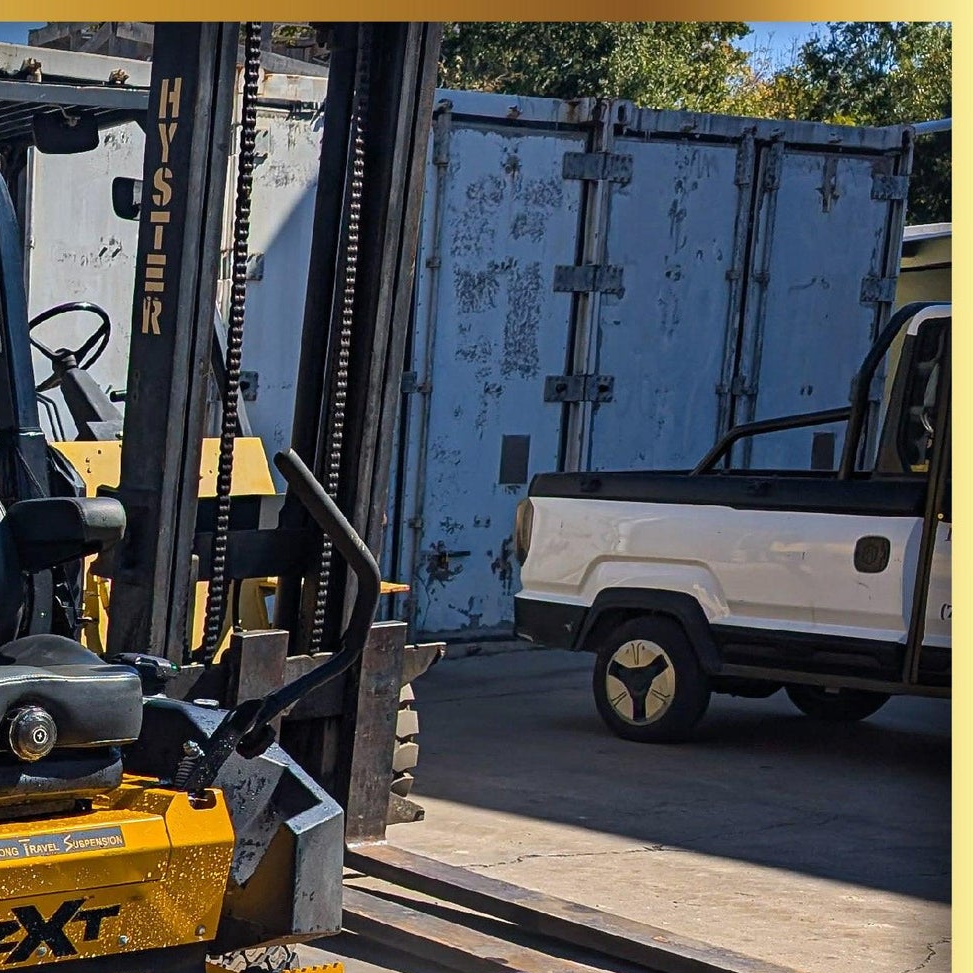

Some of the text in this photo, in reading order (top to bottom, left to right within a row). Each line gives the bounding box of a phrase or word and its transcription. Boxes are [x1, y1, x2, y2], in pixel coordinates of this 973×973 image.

[140, 77, 183, 335] HYSTER
[18, 838, 60, 856] TRAVEL
[63, 834, 123, 852] SUSPENSION
